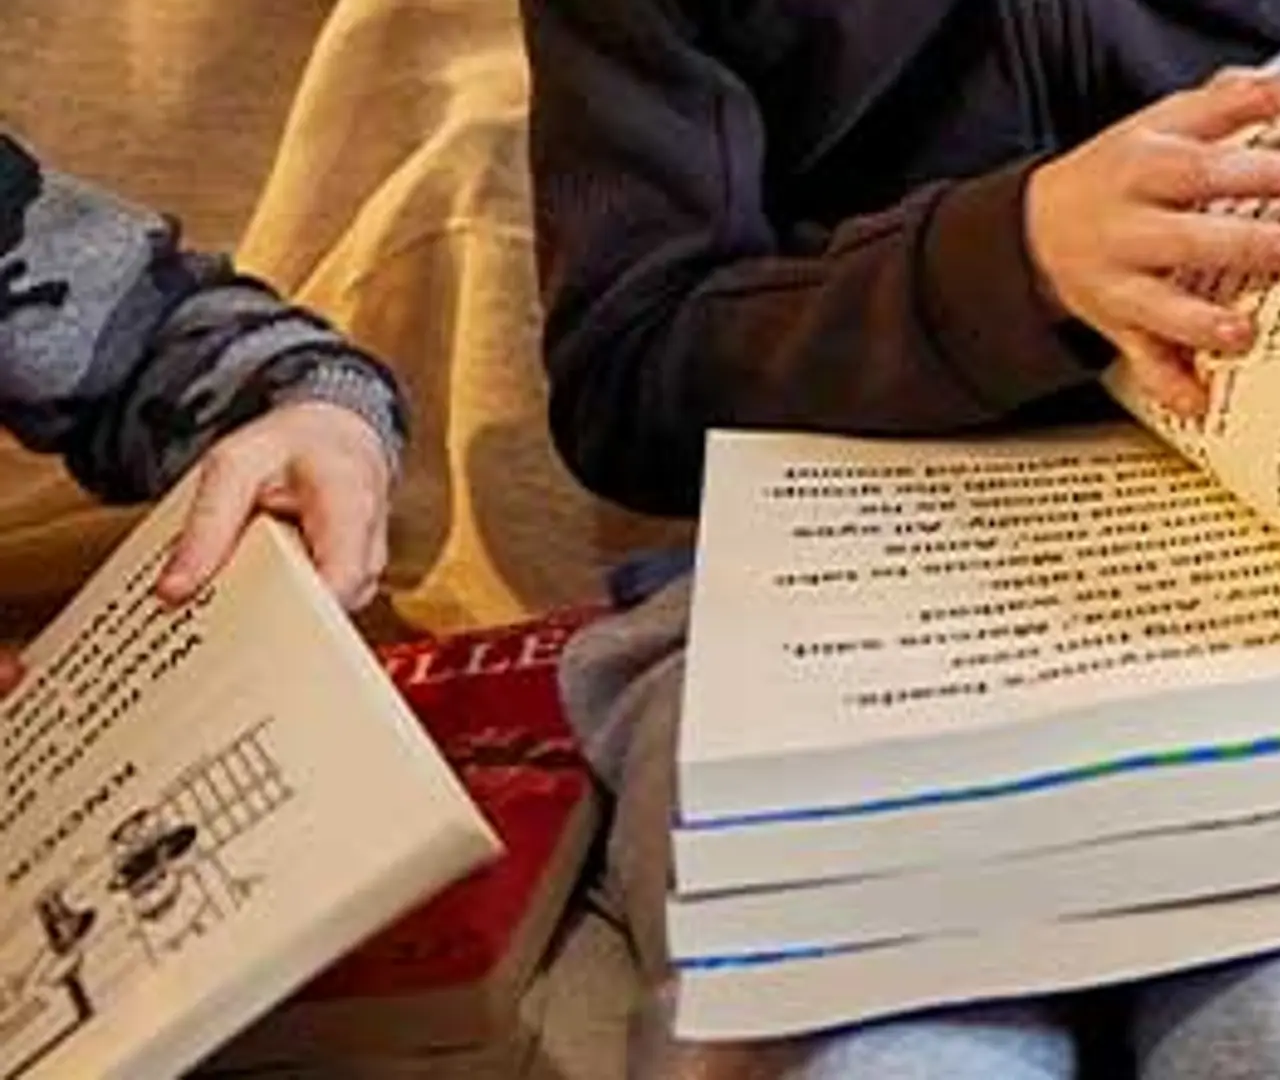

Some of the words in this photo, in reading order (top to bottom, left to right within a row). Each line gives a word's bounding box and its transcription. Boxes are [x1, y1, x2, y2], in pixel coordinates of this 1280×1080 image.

[968, 490, 1103, 508] Marcus
[893, 521, 942, 534] All
[922, 552, 1063, 576] Marcus
[1098, 560, 1157, 577] the
[773, 570, 859, 587] take
[1074, 587, 1122, 602] he
[918, 594, 1060, 622] walked
[899, 622, 1049, 647] Marcus
[1004, 641, 1231, 686] everyone's
